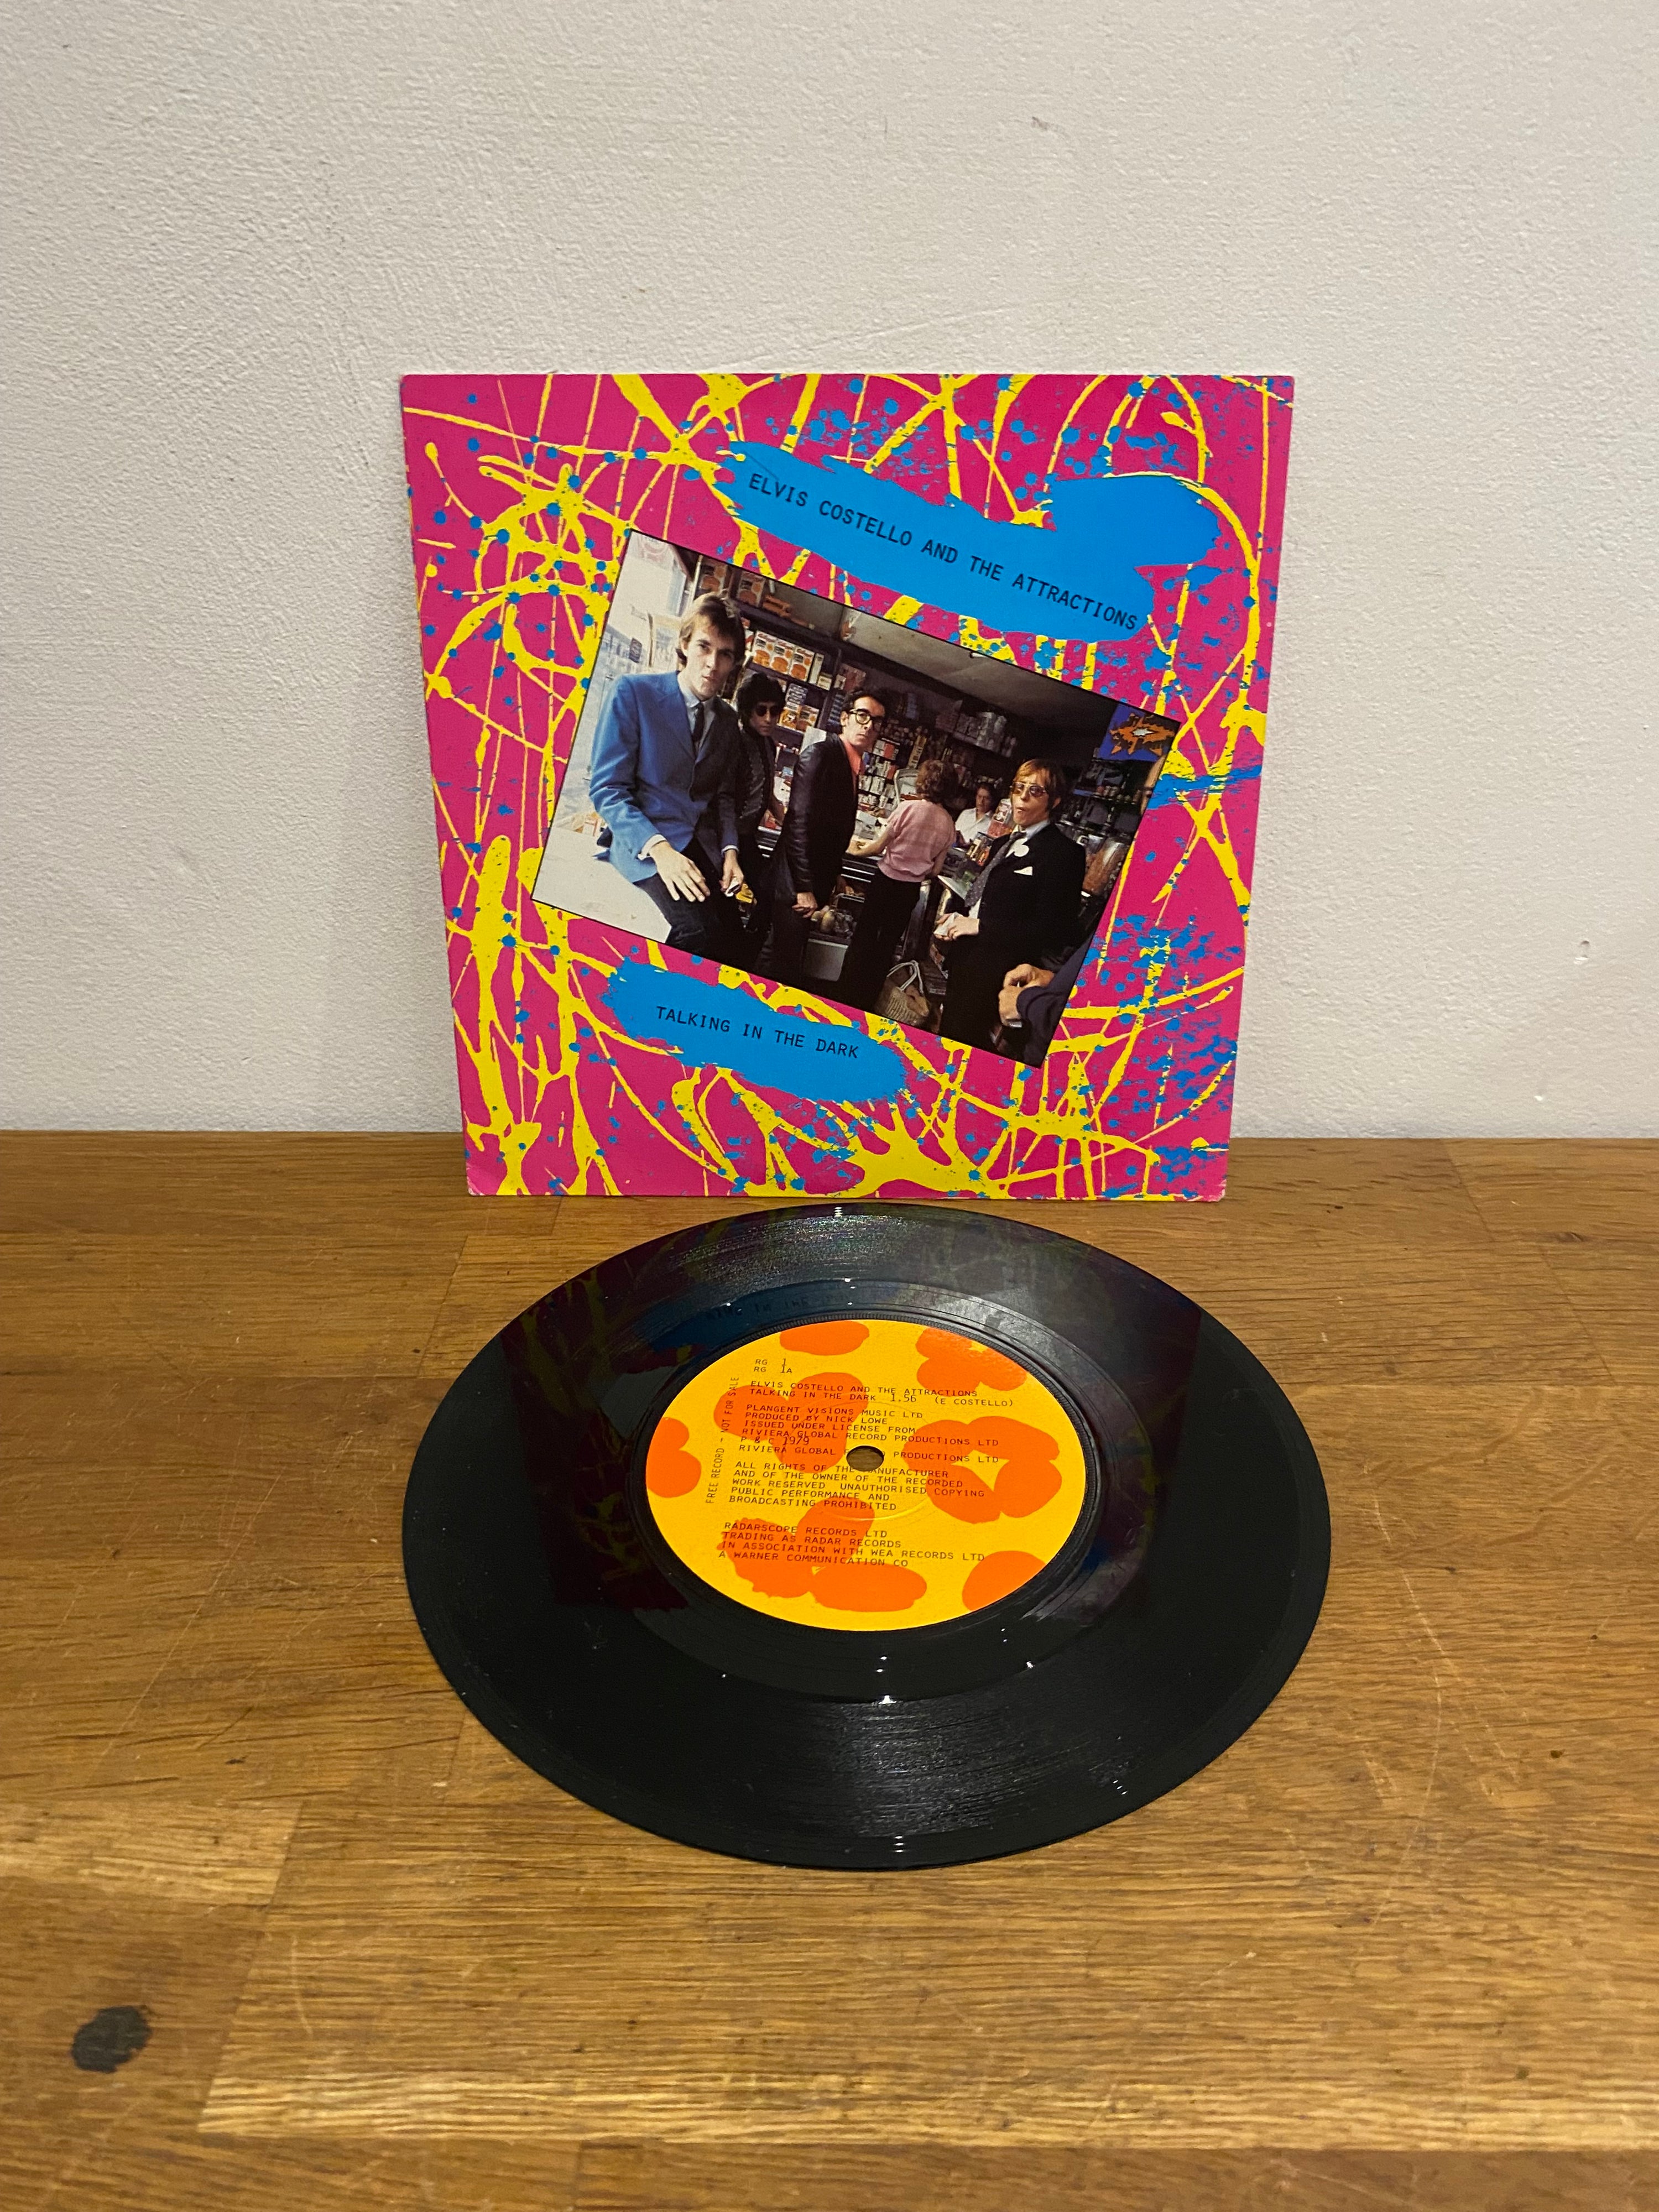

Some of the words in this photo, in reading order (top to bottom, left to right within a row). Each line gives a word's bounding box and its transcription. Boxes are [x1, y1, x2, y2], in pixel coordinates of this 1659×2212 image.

[749, 473, 809, 508] ELVIS
[818, 499, 912, 547] COSTELLO
[920, 538, 958, 565] AND
[969, 555, 1002, 582] THE
[1012, 573, 1139, 631] ATTRACTIONS
[656, 1005, 731, 1032] TALKING
[743, 1023, 763, 1040] IN
[775, 1030, 805, 1048] THE
[815, 1038, 859, 1059] DARK
[728, 1377, 739, 1396] SALE
[790, 1383, 844, 1392] COSTELLO
[904, 1388, 978, 1396] ATTRACTIONS
[750, 1389, 796, 1397] TALKING
[890, 1394, 917, 1402] 1.56
[935, 1396, 946, 1405] (E
[953, 1398, 1014, 1407] COSTELLO)
[724, 1400, 734, 1415] FOR
[747, 1404, 800, 1413] PLANGENT
[861, 1409, 896, 1417] MUSIC
[745, 1412, 800, 1421] PRODUCED
[721, 1418, 731, 1433] NOT
[744, 1420, 785, 1429] ISSUED
[832, 1424, 880, 1433] LICENSE
[742, 1428, 790, 1437] RIVIERA
[797, 1431, 837, 1439] GLOBAL
[846, 1433, 887, 1441] RECORD
[894, 1435, 970, 1445] PRODUCTIONS
[782, 1436, 810, 1446] 1979
[739, 1444, 786, 1453] RIVIERA
[795, 1447, 837, 1455] GLOBAL
[894, 1451, 971, 1462] PRODUCTIONS
[711, 1448, 725, 1478] RECORD
[764, 1463, 806, 1471] RIGHTS
[866, 1467, 948, 1478] ANUFACTURER
[732, 1478, 760, 1486] WORK
[768, 1480, 826, 1489] RESERVED
[840, 1483, 927, 1494] UNAUTHORISED
[934, 1488, 985, 1498] COPYING
[906, 1478, 963, 1487] RECORDED
[705, 1482, 719, 1504] FREE
[731, 1486, 774, 1496] PUBLIC
[781, 1490, 860, 1499] PERFORMANCE
[729, 1495, 816, 1506] BROADCASTING
[823, 1500, 897, 1511] PROHIBITED
[724, 1522, 798, 1533] RADARSCOPE
[806, 1527, 857, 1536] RECORDS
[722, 1531, 774, 1541] TRADING
[804, 1536, 841, 1545] RADAR
[849, 1538, 901, 1548] RECORDS
[733, 1551, 779, 1561] WARNER
[786, 1554, 885, 1566] COMMUNICATION
[893, 1559, 909, 1567] CO
[743, 1542, 826, 1553] ASSOCIATION
[871, 1549, 894, 1557] WEA
[901, 1550, 954, 1559] RECORDS
[963, 1553, 985, 1561] LTD
